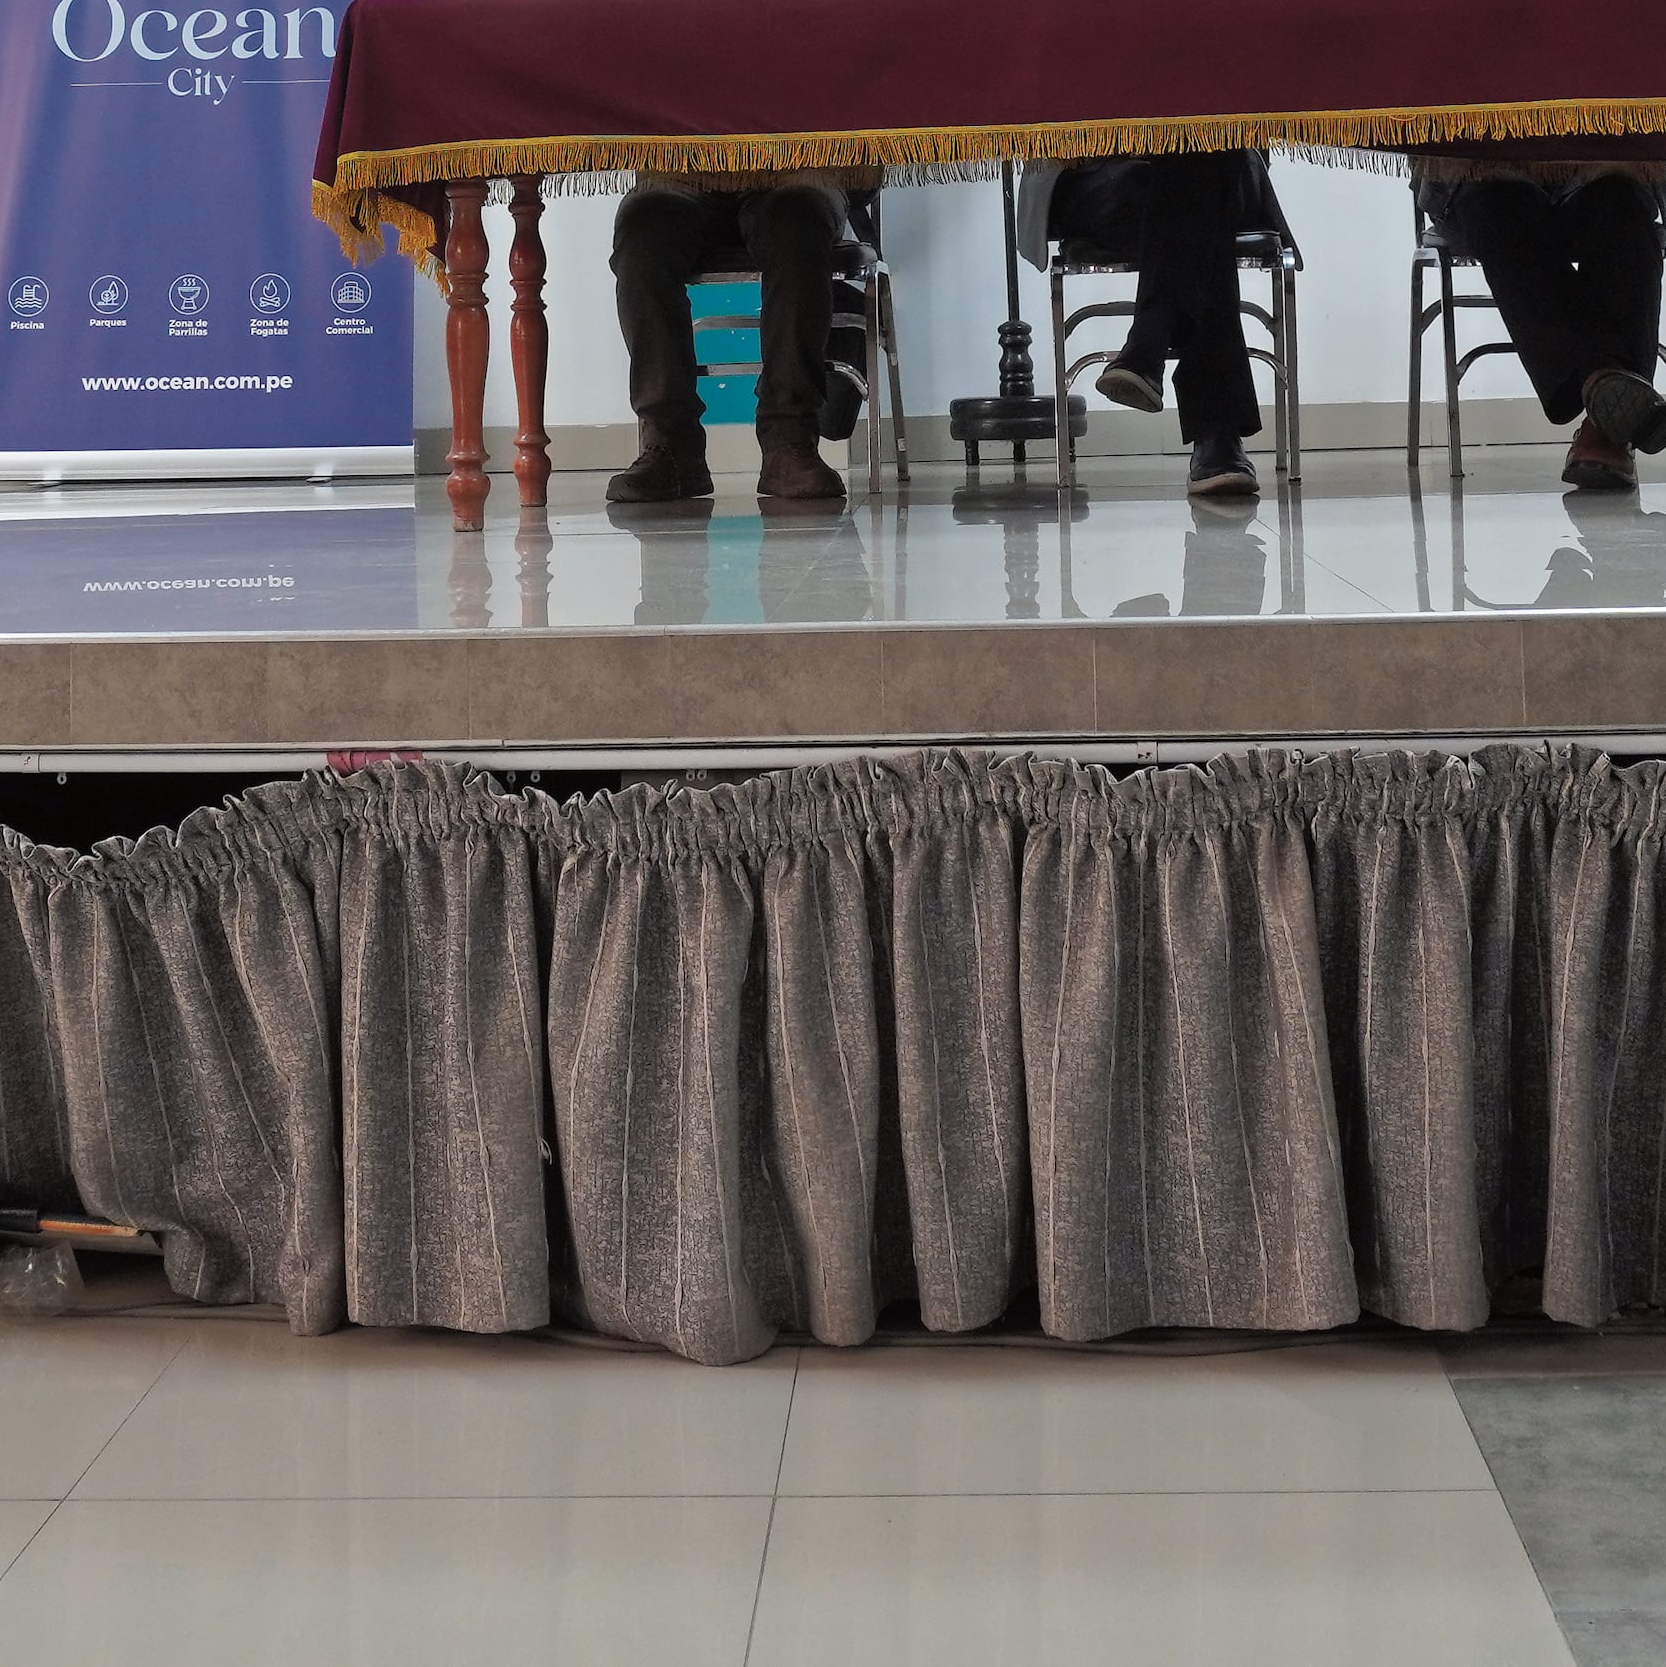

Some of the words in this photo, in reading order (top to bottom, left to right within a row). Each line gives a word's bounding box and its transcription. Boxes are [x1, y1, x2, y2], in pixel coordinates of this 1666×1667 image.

[167, 67, 236, 106] City
[10, 321, 45, 330] Piscina
[89, 319, 127, 328] Parques
[169, 319, 194, 328] Zona
[195, 319, 208, 328] de
[250, 318, 275, 327] Zona
[276, 318, 289, 327] de
[333, 317, 366, 326] Centro
[168, 328, 208, 336] Parrillas
[250, 327, 289, 337] Fogatas
[325, 326, 374, 335] Comercial
[81, 374, 293, 393] www.ocean.com.pe
